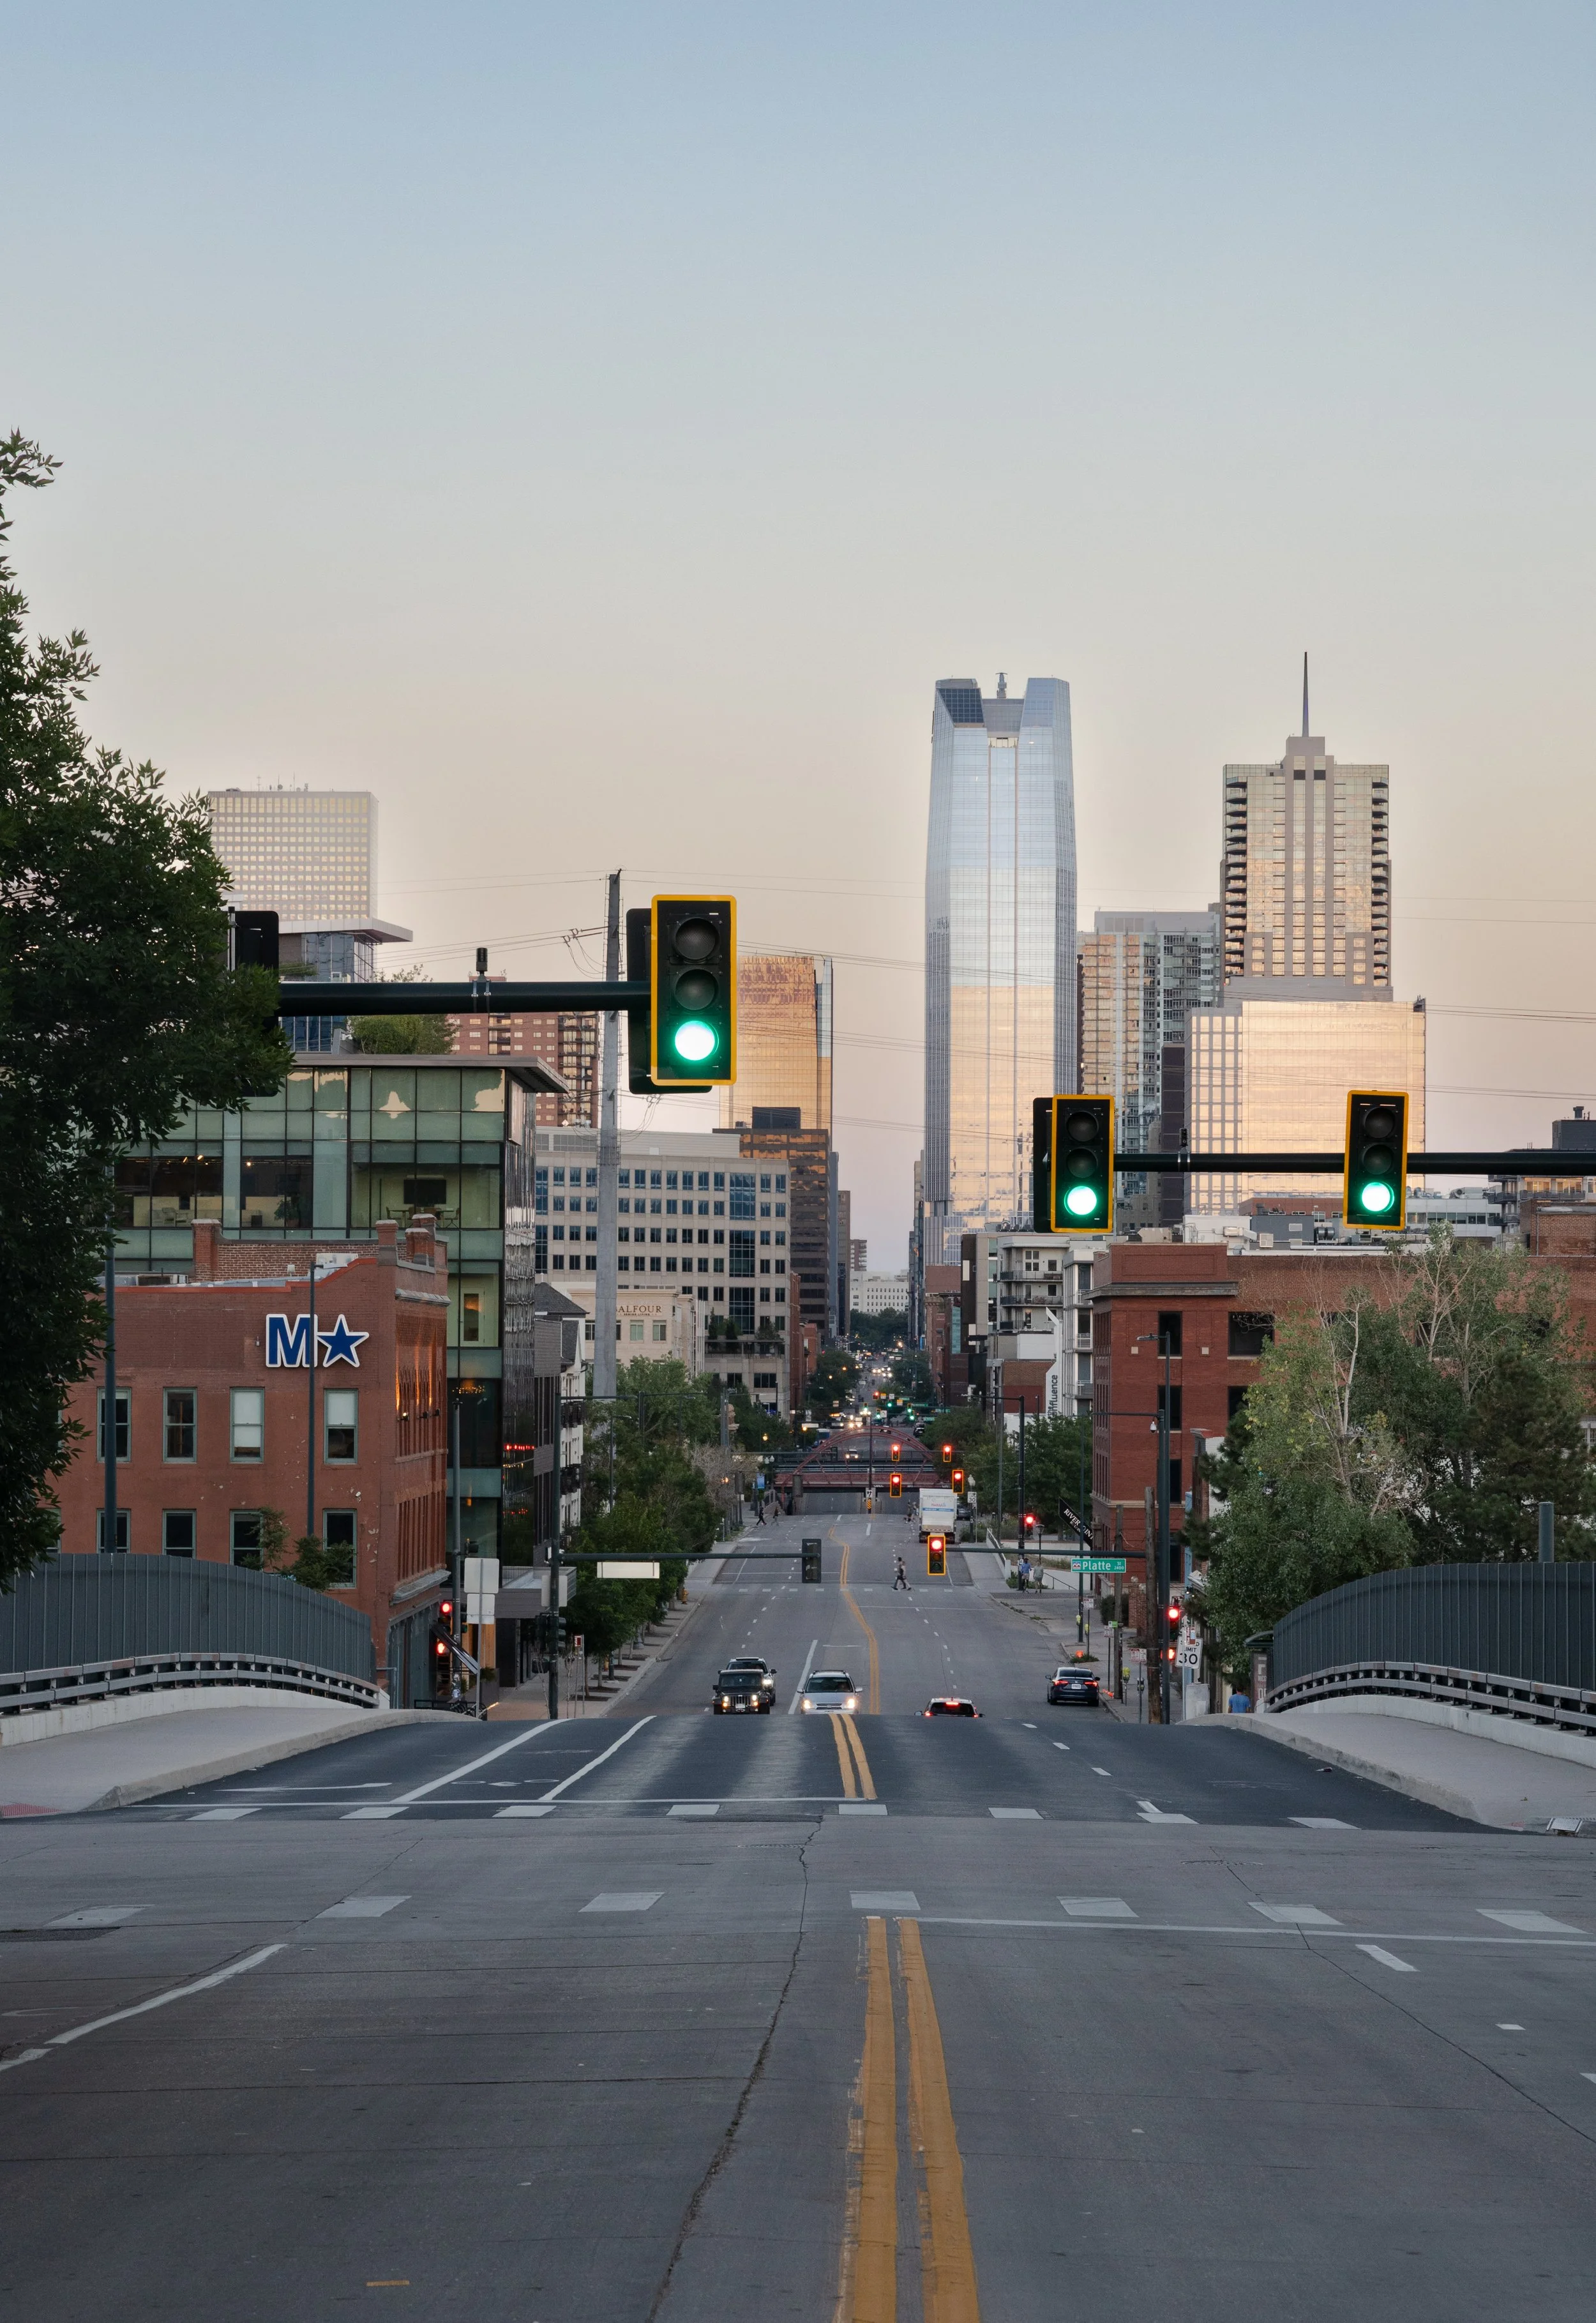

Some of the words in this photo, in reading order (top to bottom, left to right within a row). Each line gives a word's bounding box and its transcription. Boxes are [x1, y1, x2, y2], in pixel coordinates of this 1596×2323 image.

[266, 1313, 318, 1368] M
[1083, 1561, 1111, 1570] Platte
[1178, 1653, 1198, 1665] 30
